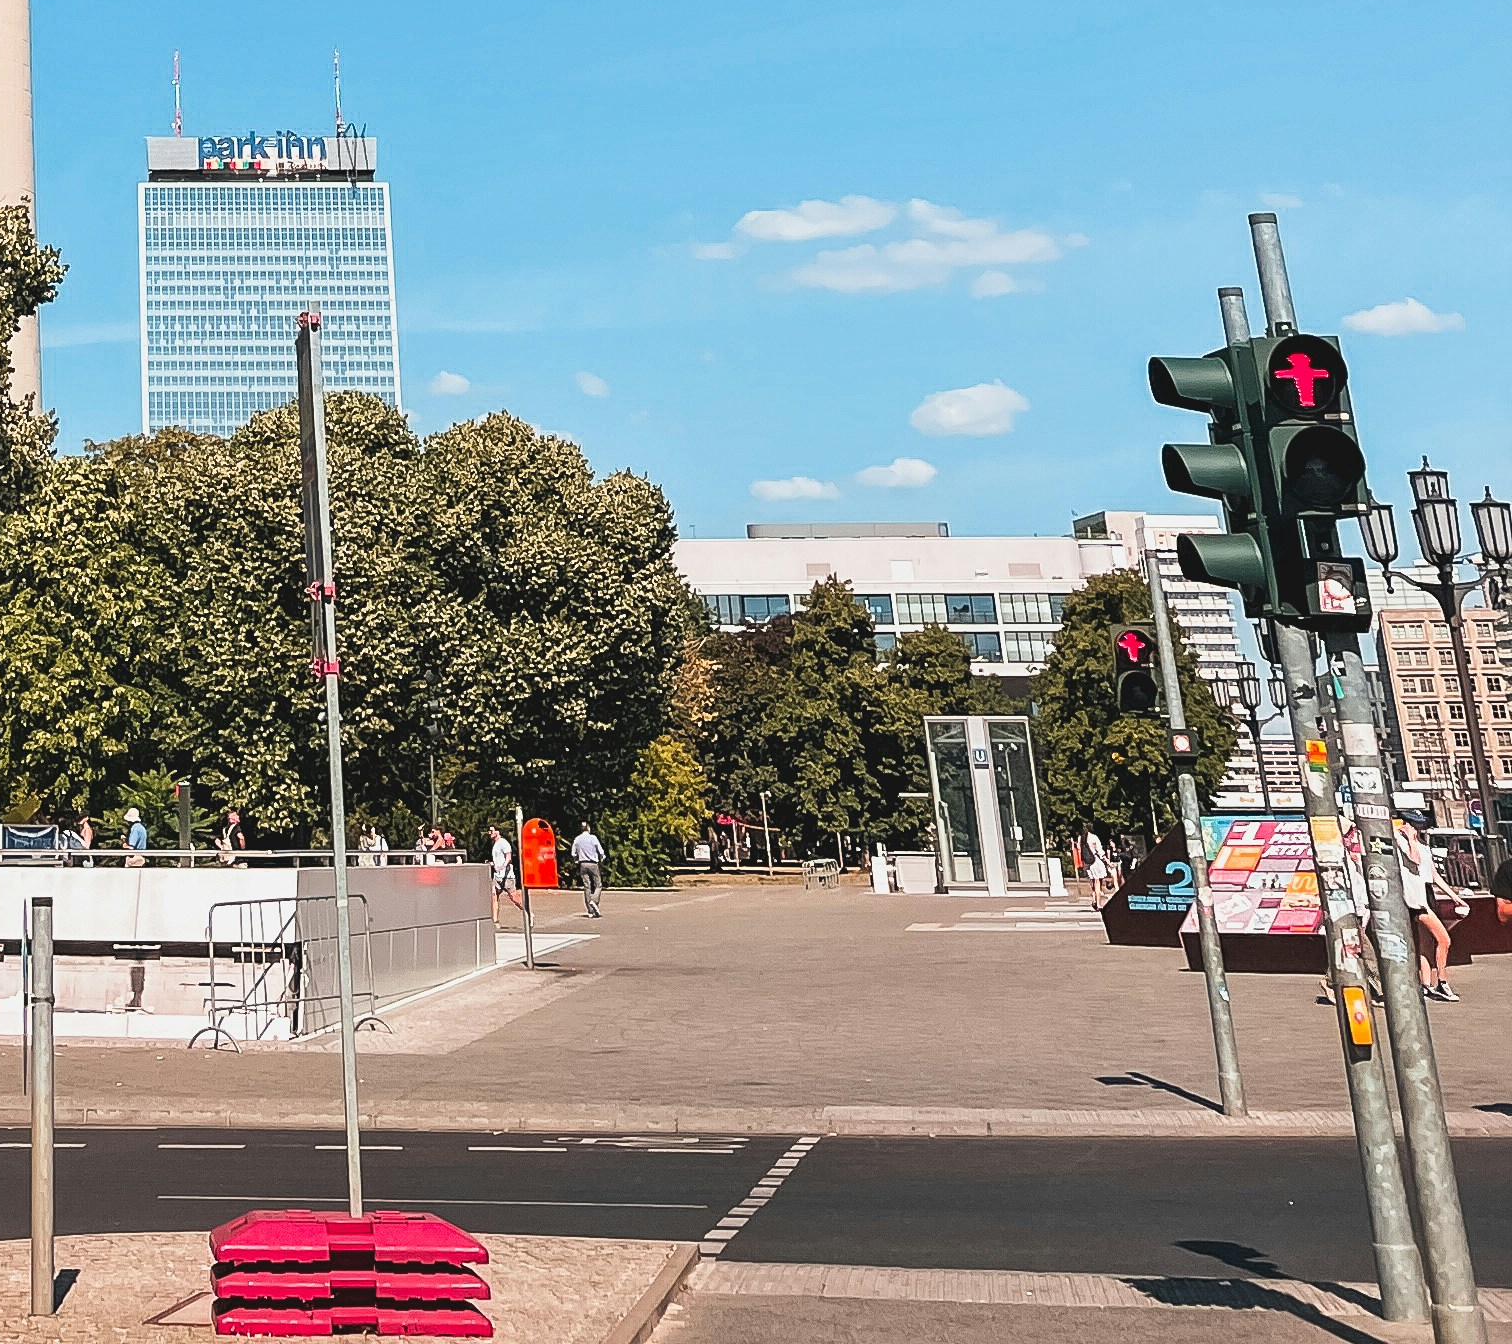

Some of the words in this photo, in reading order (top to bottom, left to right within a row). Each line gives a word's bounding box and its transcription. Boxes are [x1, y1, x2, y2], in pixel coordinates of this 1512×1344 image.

[199, 131, 270, 168] park
[275, 130, 327, 160] inn
[1227, 821, 1266, 846] 1
[1165, 861, 1196, 896] 2
